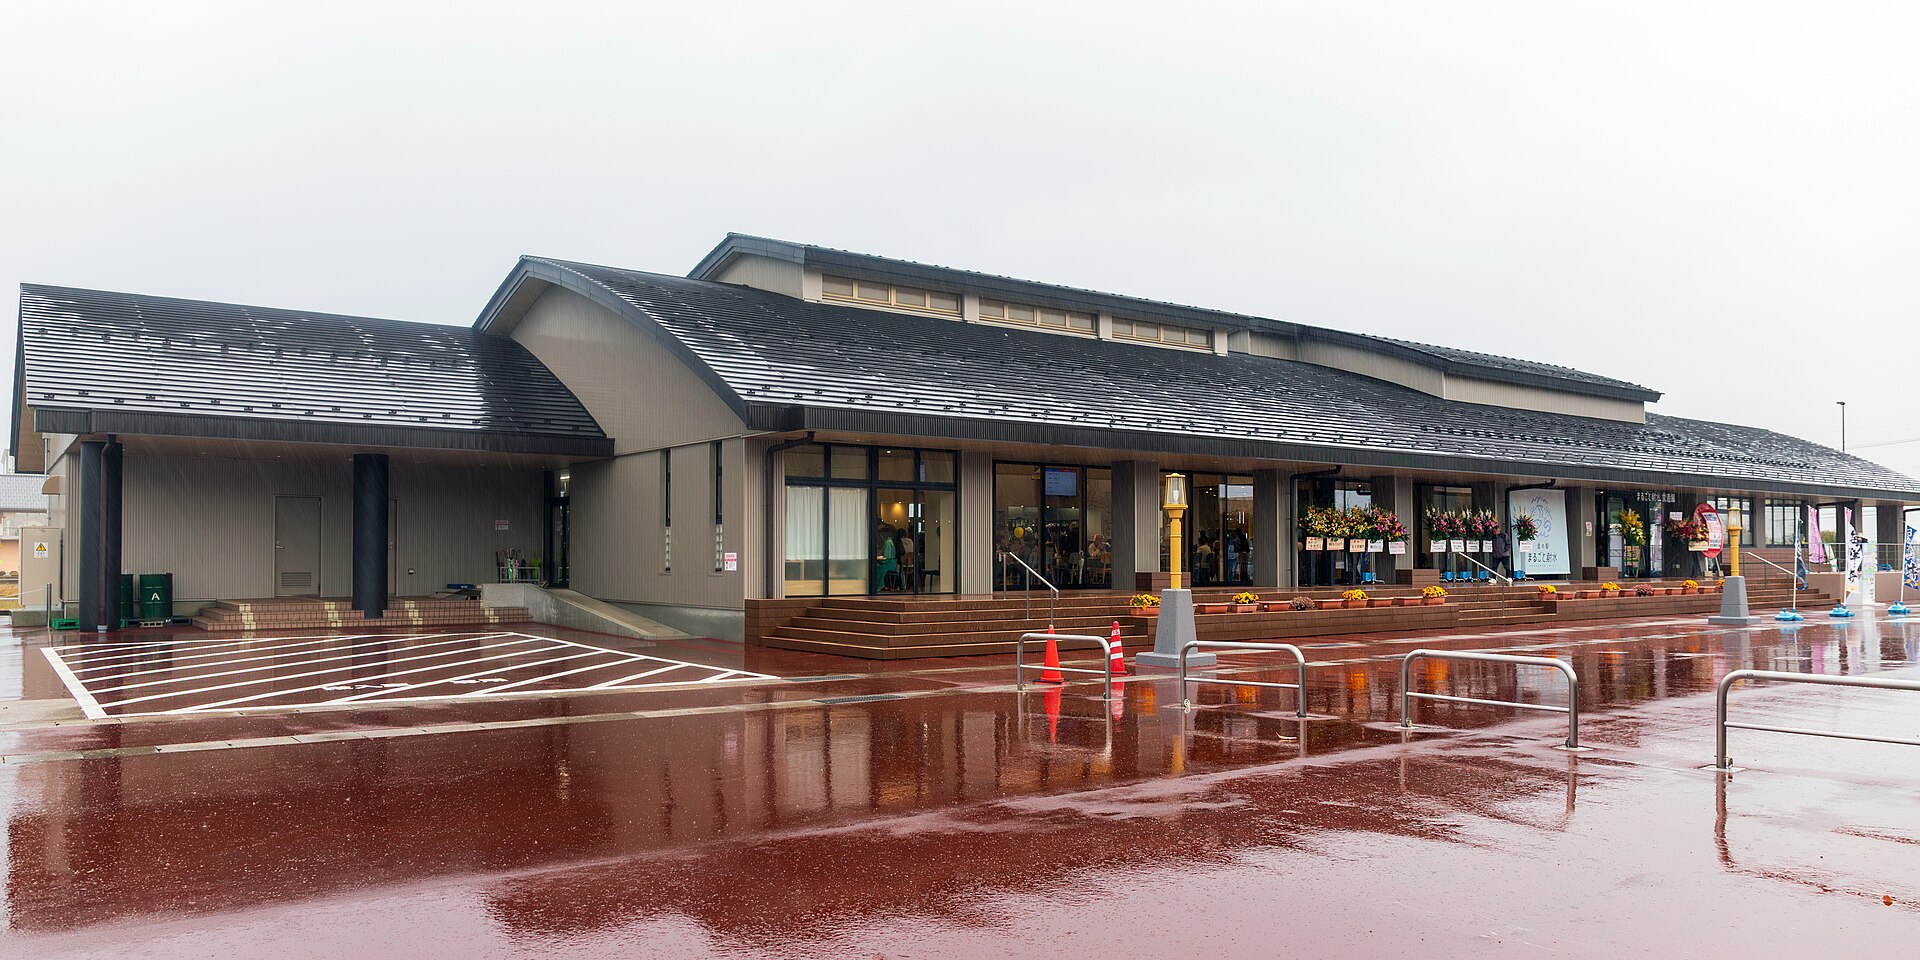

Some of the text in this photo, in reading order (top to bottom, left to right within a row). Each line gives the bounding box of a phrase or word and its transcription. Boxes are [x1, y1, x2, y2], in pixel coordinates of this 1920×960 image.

[1528, 551, 1558, 563] まるごと射水
[151, 592, 160, 601] A
